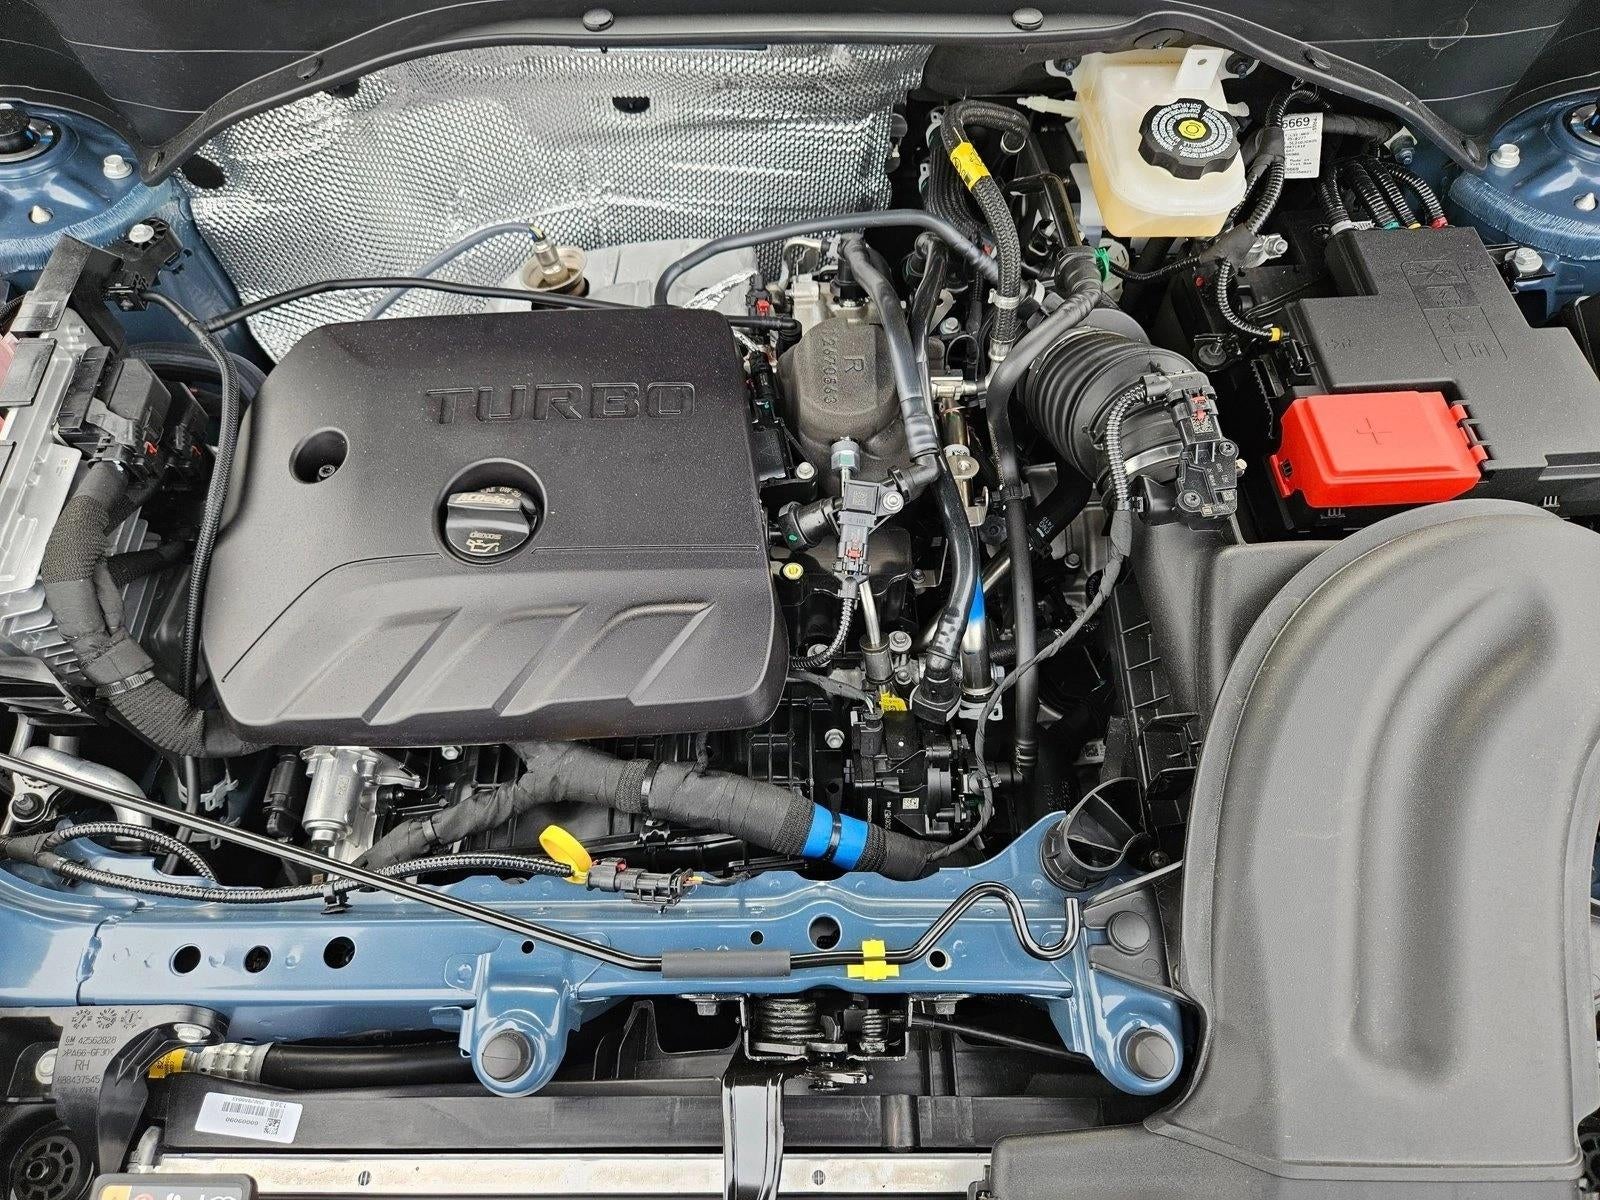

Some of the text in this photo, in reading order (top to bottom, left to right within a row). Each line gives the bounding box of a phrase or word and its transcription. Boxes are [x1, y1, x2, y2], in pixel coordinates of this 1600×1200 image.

[844, 358, 865, 373] R
[426, 382, 695, 424] TURBO
[74, 1059, 90, 1071] RH
